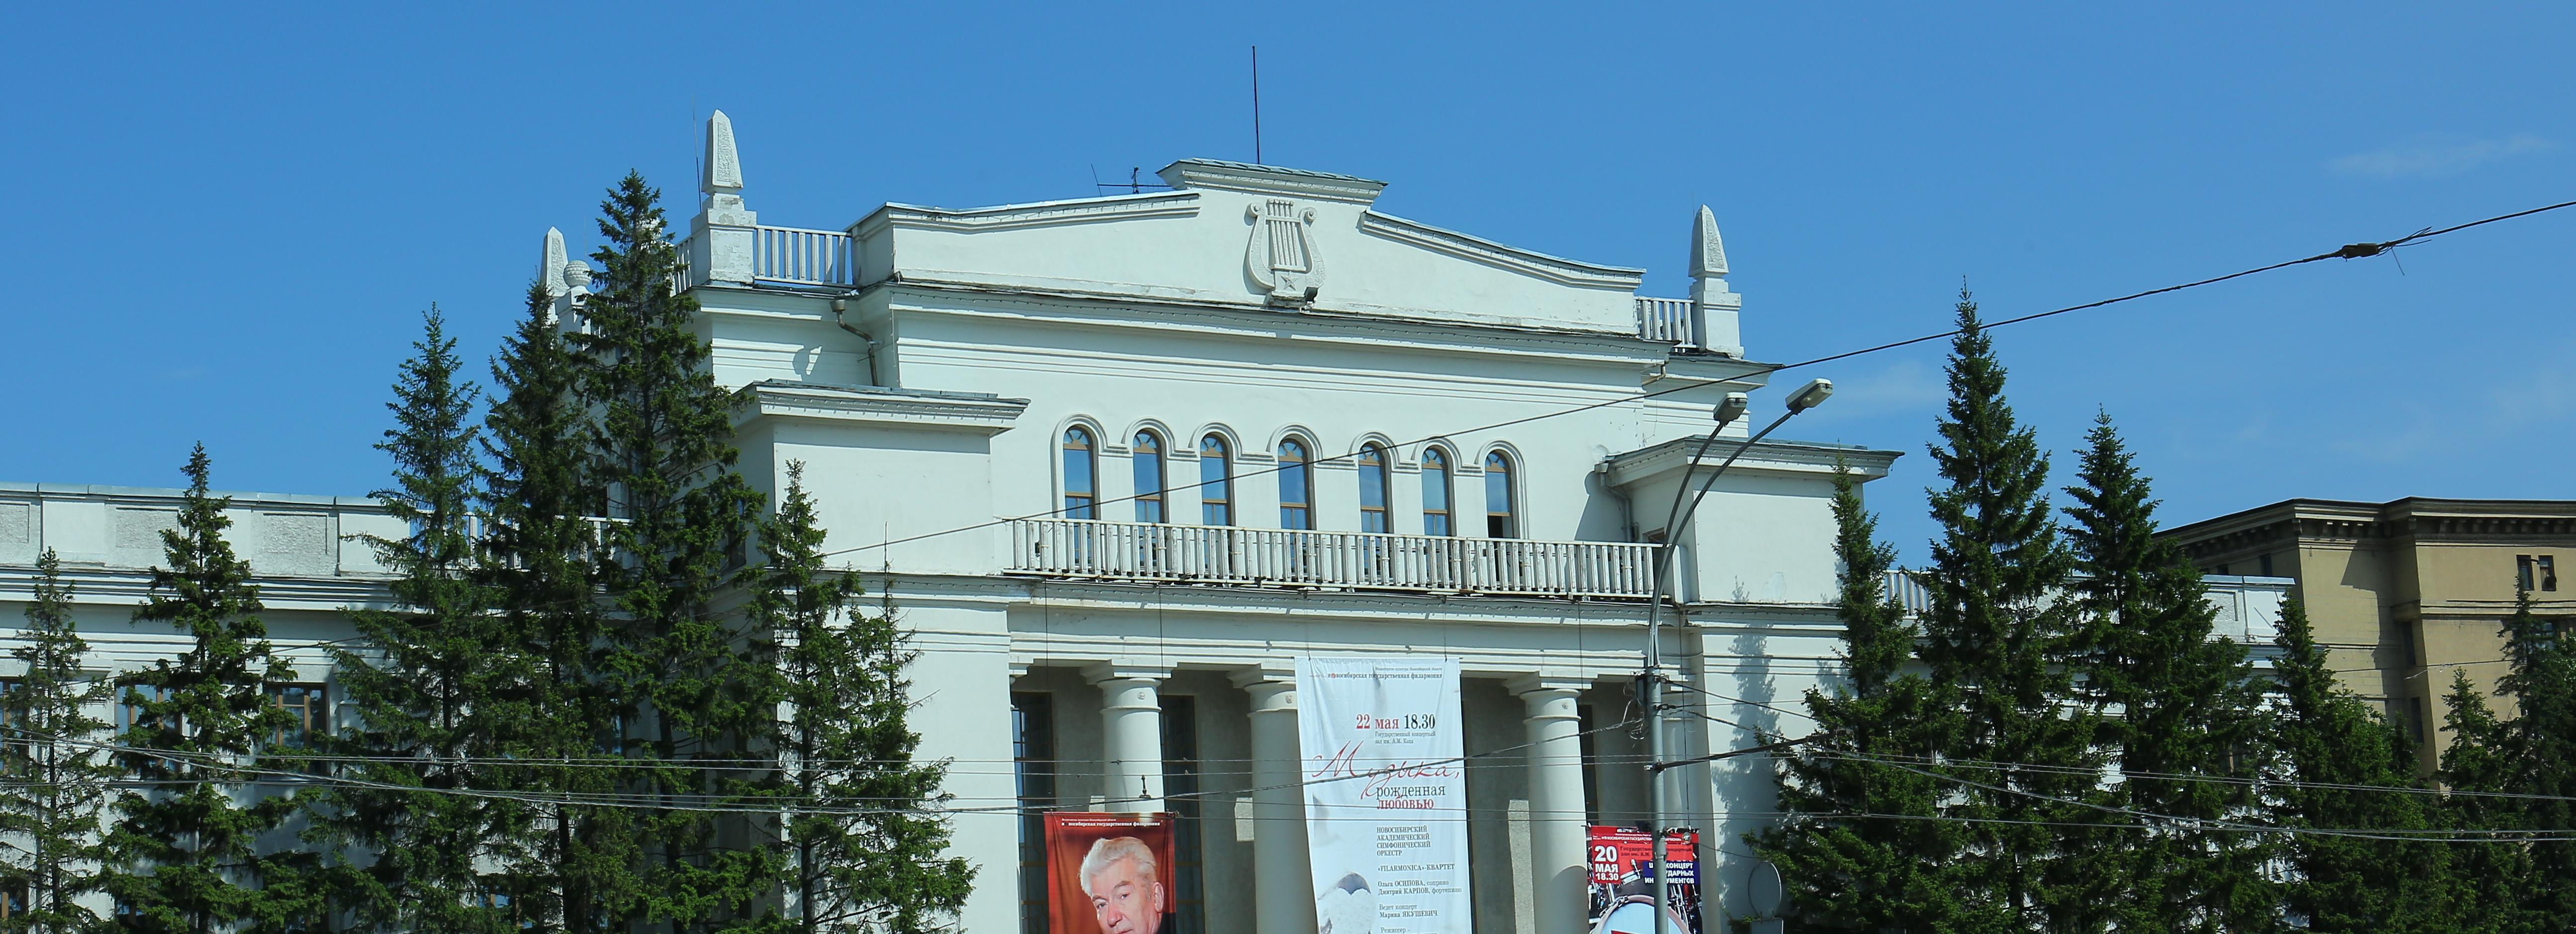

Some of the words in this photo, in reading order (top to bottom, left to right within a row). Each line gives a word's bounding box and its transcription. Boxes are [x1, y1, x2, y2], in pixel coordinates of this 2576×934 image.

[1356, 714, 1370, 729] 22
[1375, 719, 1399, 729] мая
[1404, 714, 1435, 729] 18.30
[1376, 785, 1446, 800] рожденная
[1376, 796, 1434, 810] любовью
[1376, 825, 1428, 834] НОВОСИБИРСКИЙ
[1376, 833, 1430, 841] АКАДЕМИЧЕСКИЙ
[1594, 845, 1618, 862] 20
[1595, 863, 1619, 873] МАЯ
